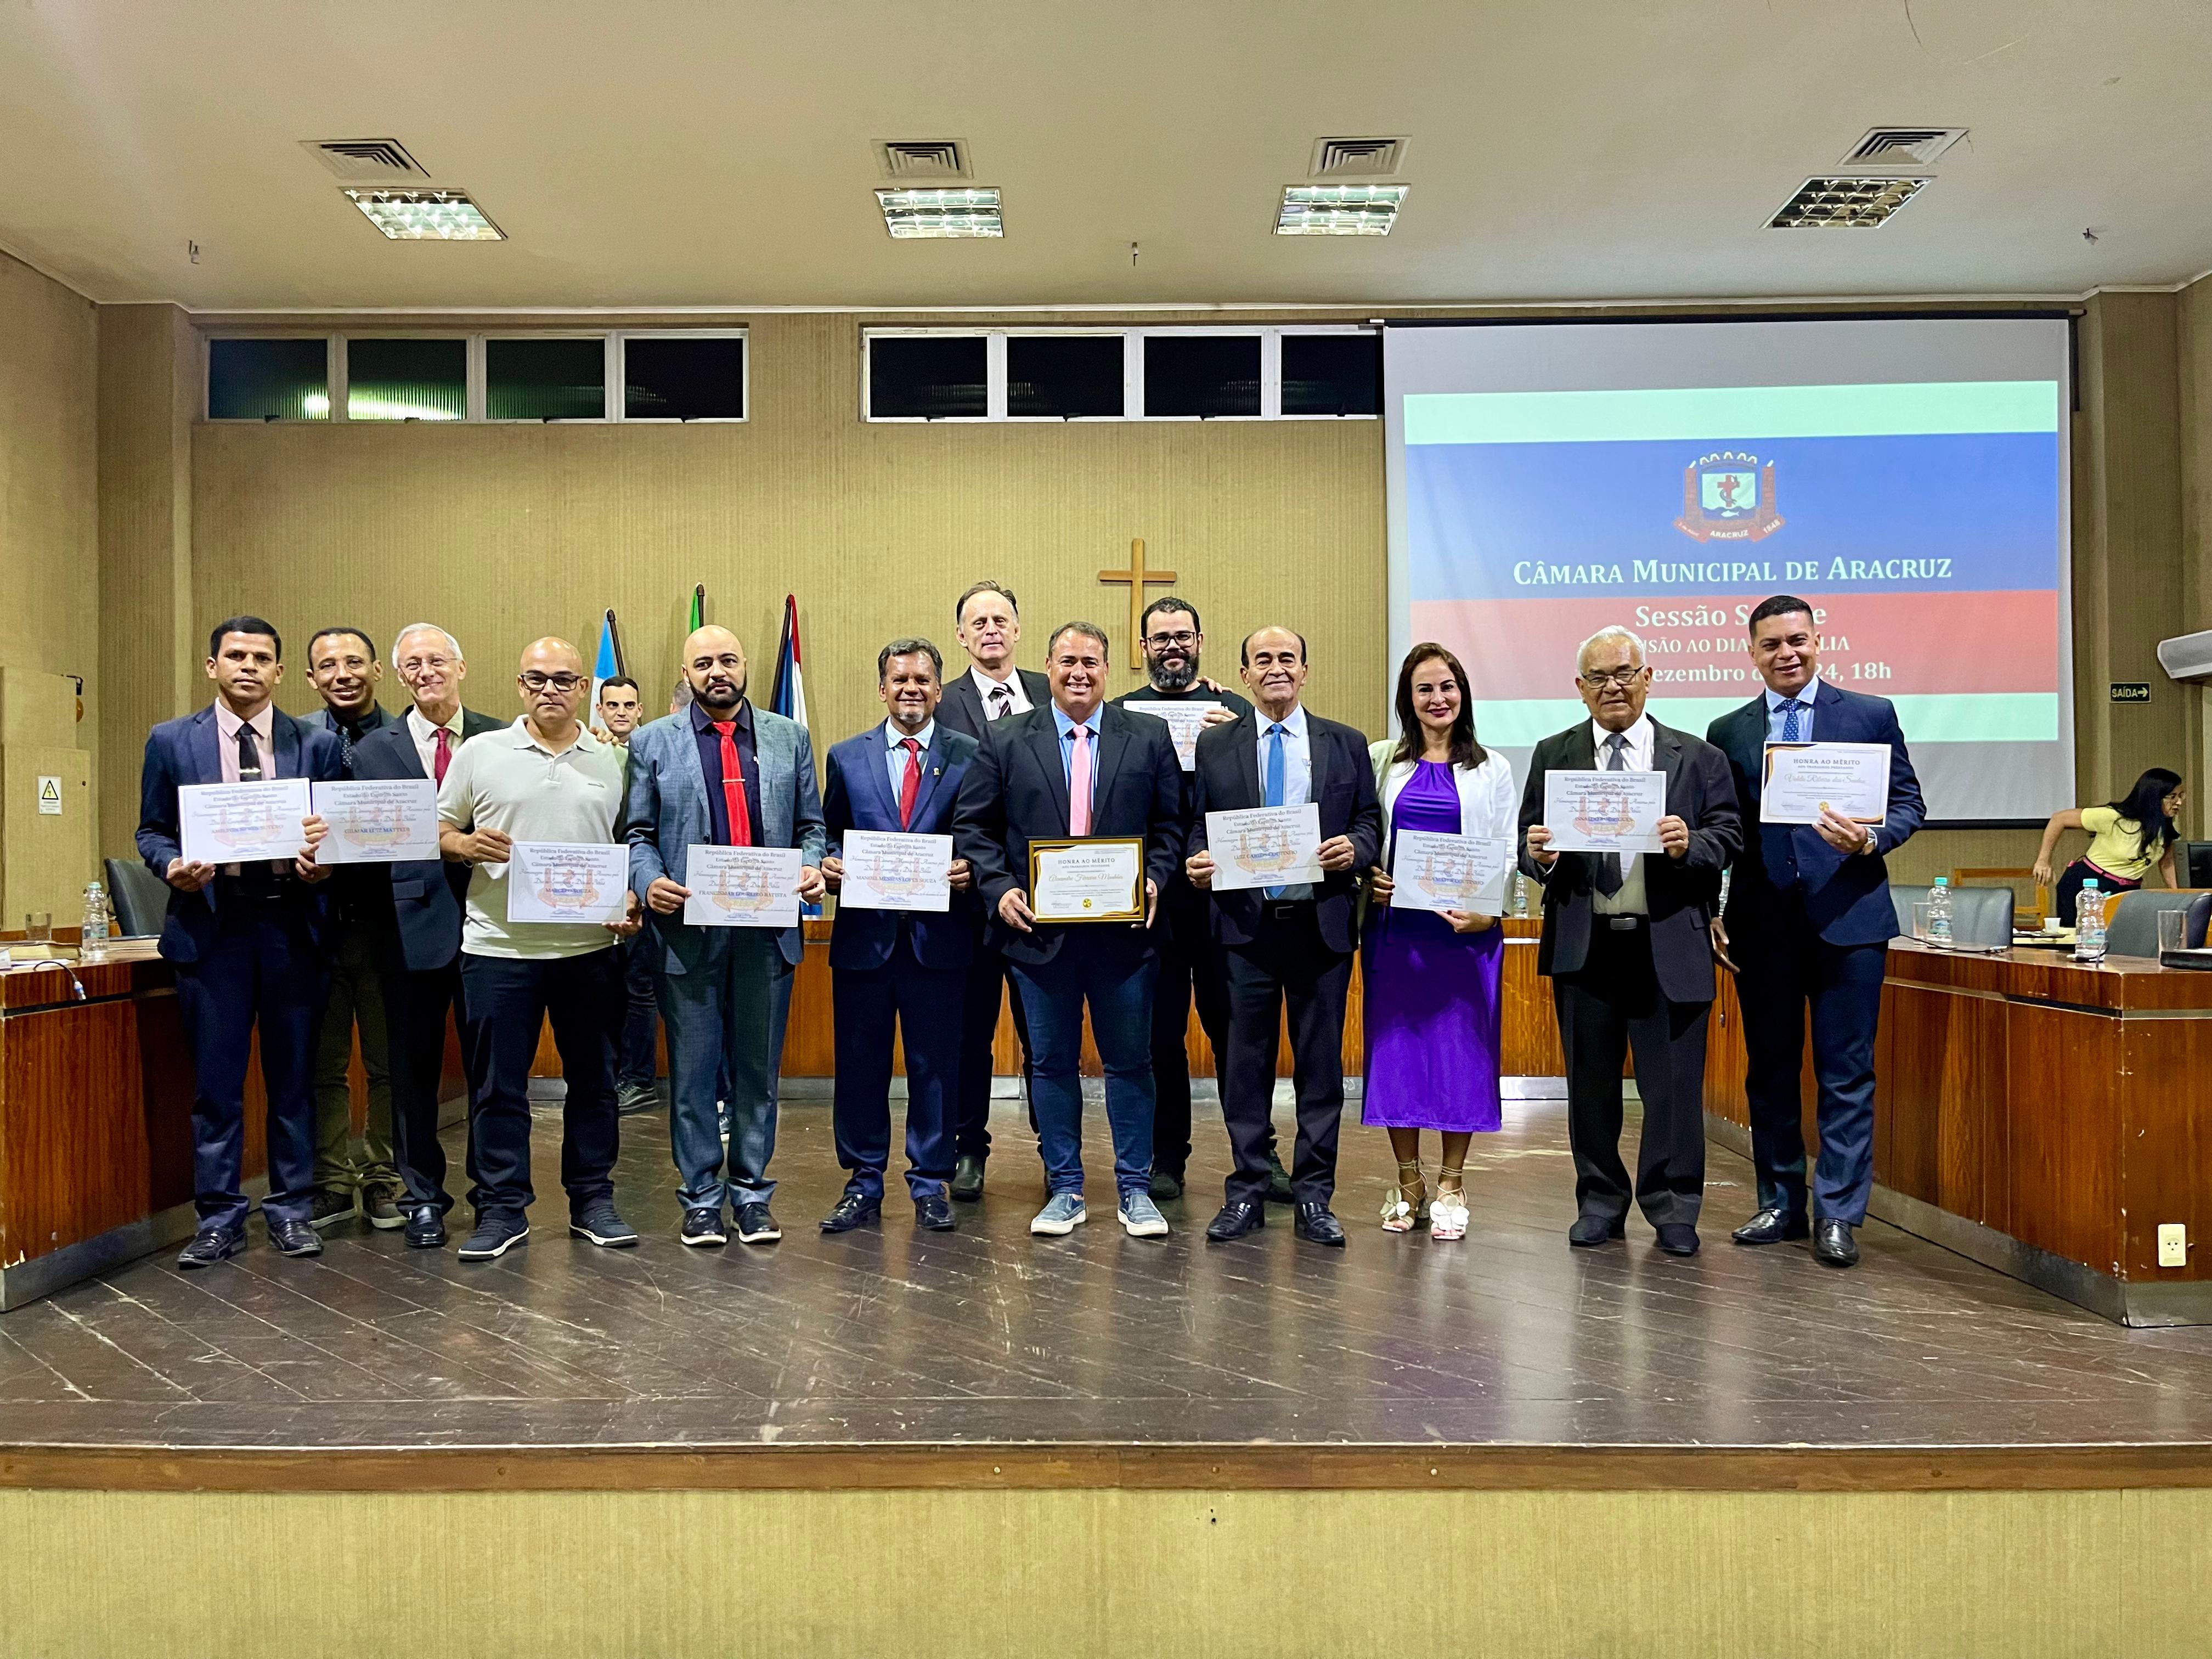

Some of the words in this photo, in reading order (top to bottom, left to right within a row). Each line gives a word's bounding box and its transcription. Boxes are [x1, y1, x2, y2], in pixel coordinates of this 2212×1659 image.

[1710, 529, 1748, 538] ARACRUZ
[1763, 520, 1780, 533] 1848
[1513, 561, 1624, 584] CÂMARA
[1633, 559, 1777, 583] MUNICIPAL
[1785, 561, 1819, 580] DE
[1826, 556, 1951, 580] ARACRUZ
[1635, 605, 1726, 627] Sessão
[1647, 637, 1681, 653] SÃO
[1686, 639, 1711, 653] AO
[1716, 638, 1748, 652] DIA
[1820, 636, 1850, 651] LIA
[1652, 664, 1745, 682] ezembro
[1815, 663, 1843, 682] 24,
[1851, 662, 1892, 679] 18h
[2112, 686, 2138, 697] SAÍDA
